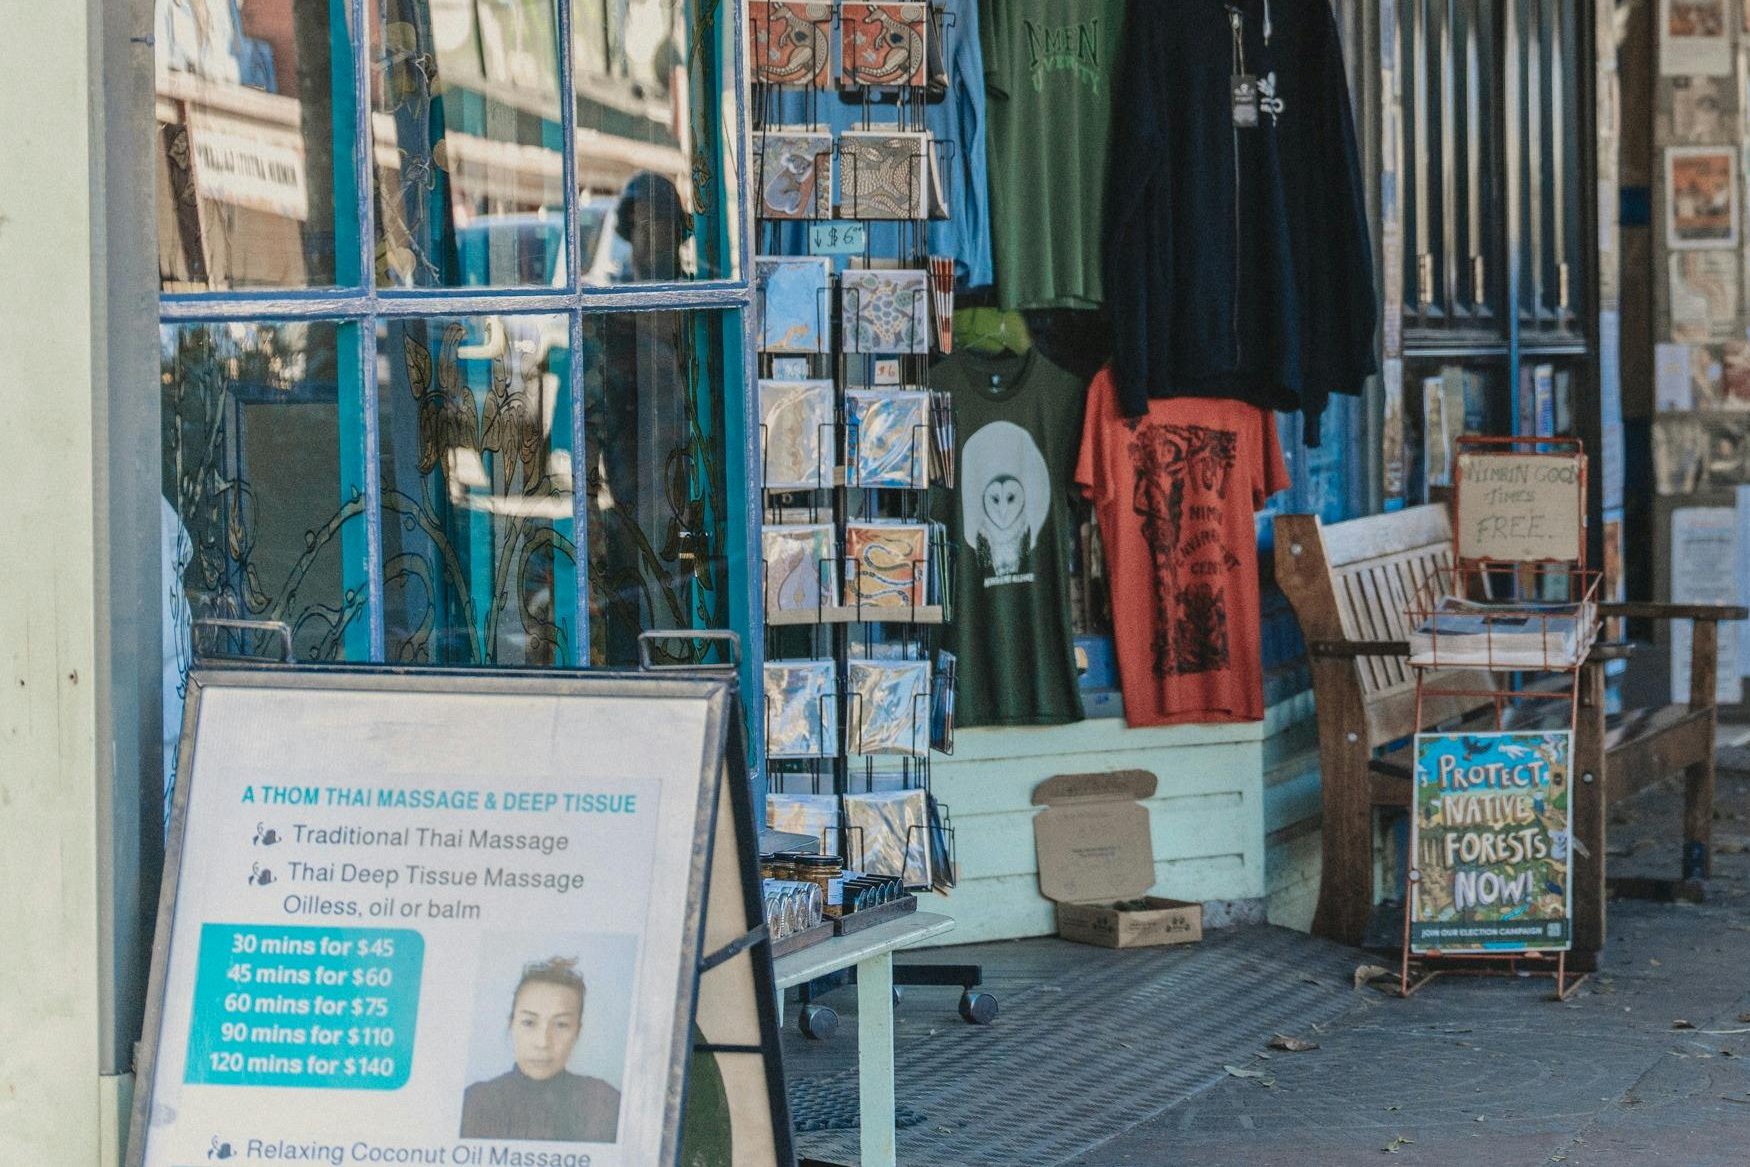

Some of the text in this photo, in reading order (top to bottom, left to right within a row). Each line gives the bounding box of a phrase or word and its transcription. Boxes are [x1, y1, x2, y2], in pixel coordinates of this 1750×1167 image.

[1439, 753, 1545, 791] PROTECT
[242, 786, 637, 813] A THOM THAI MASSAGE & DEEP TISSUE
[1443, 794, 1530, 827] NATIVE
[293, 824, 569, 855] Traditional Thai Massage
[1444, 828, 1547, 870] FORESTS
[288, 861, 584, 894] Thai Deep Tissue Massage
[1454, 870, 1534, 912] NOW!
[284, 894, 481, 920] Oilless, oil or balm
[1498, 926, 1543, 936] CAMPAIGN
[232, 934, 394, 957] 30 mins for $45
[227, 964, 392, 986] 45 mins for $60
[225, 994, 388, 1017] 60 mins for $75
[221, 1023, 394, 1046] 90 mins for $110
[210, 1052, 394, 1076] 120 mins for $140
[247, 1139, 591, 1167] Relaxing Coconut Oil Massage
